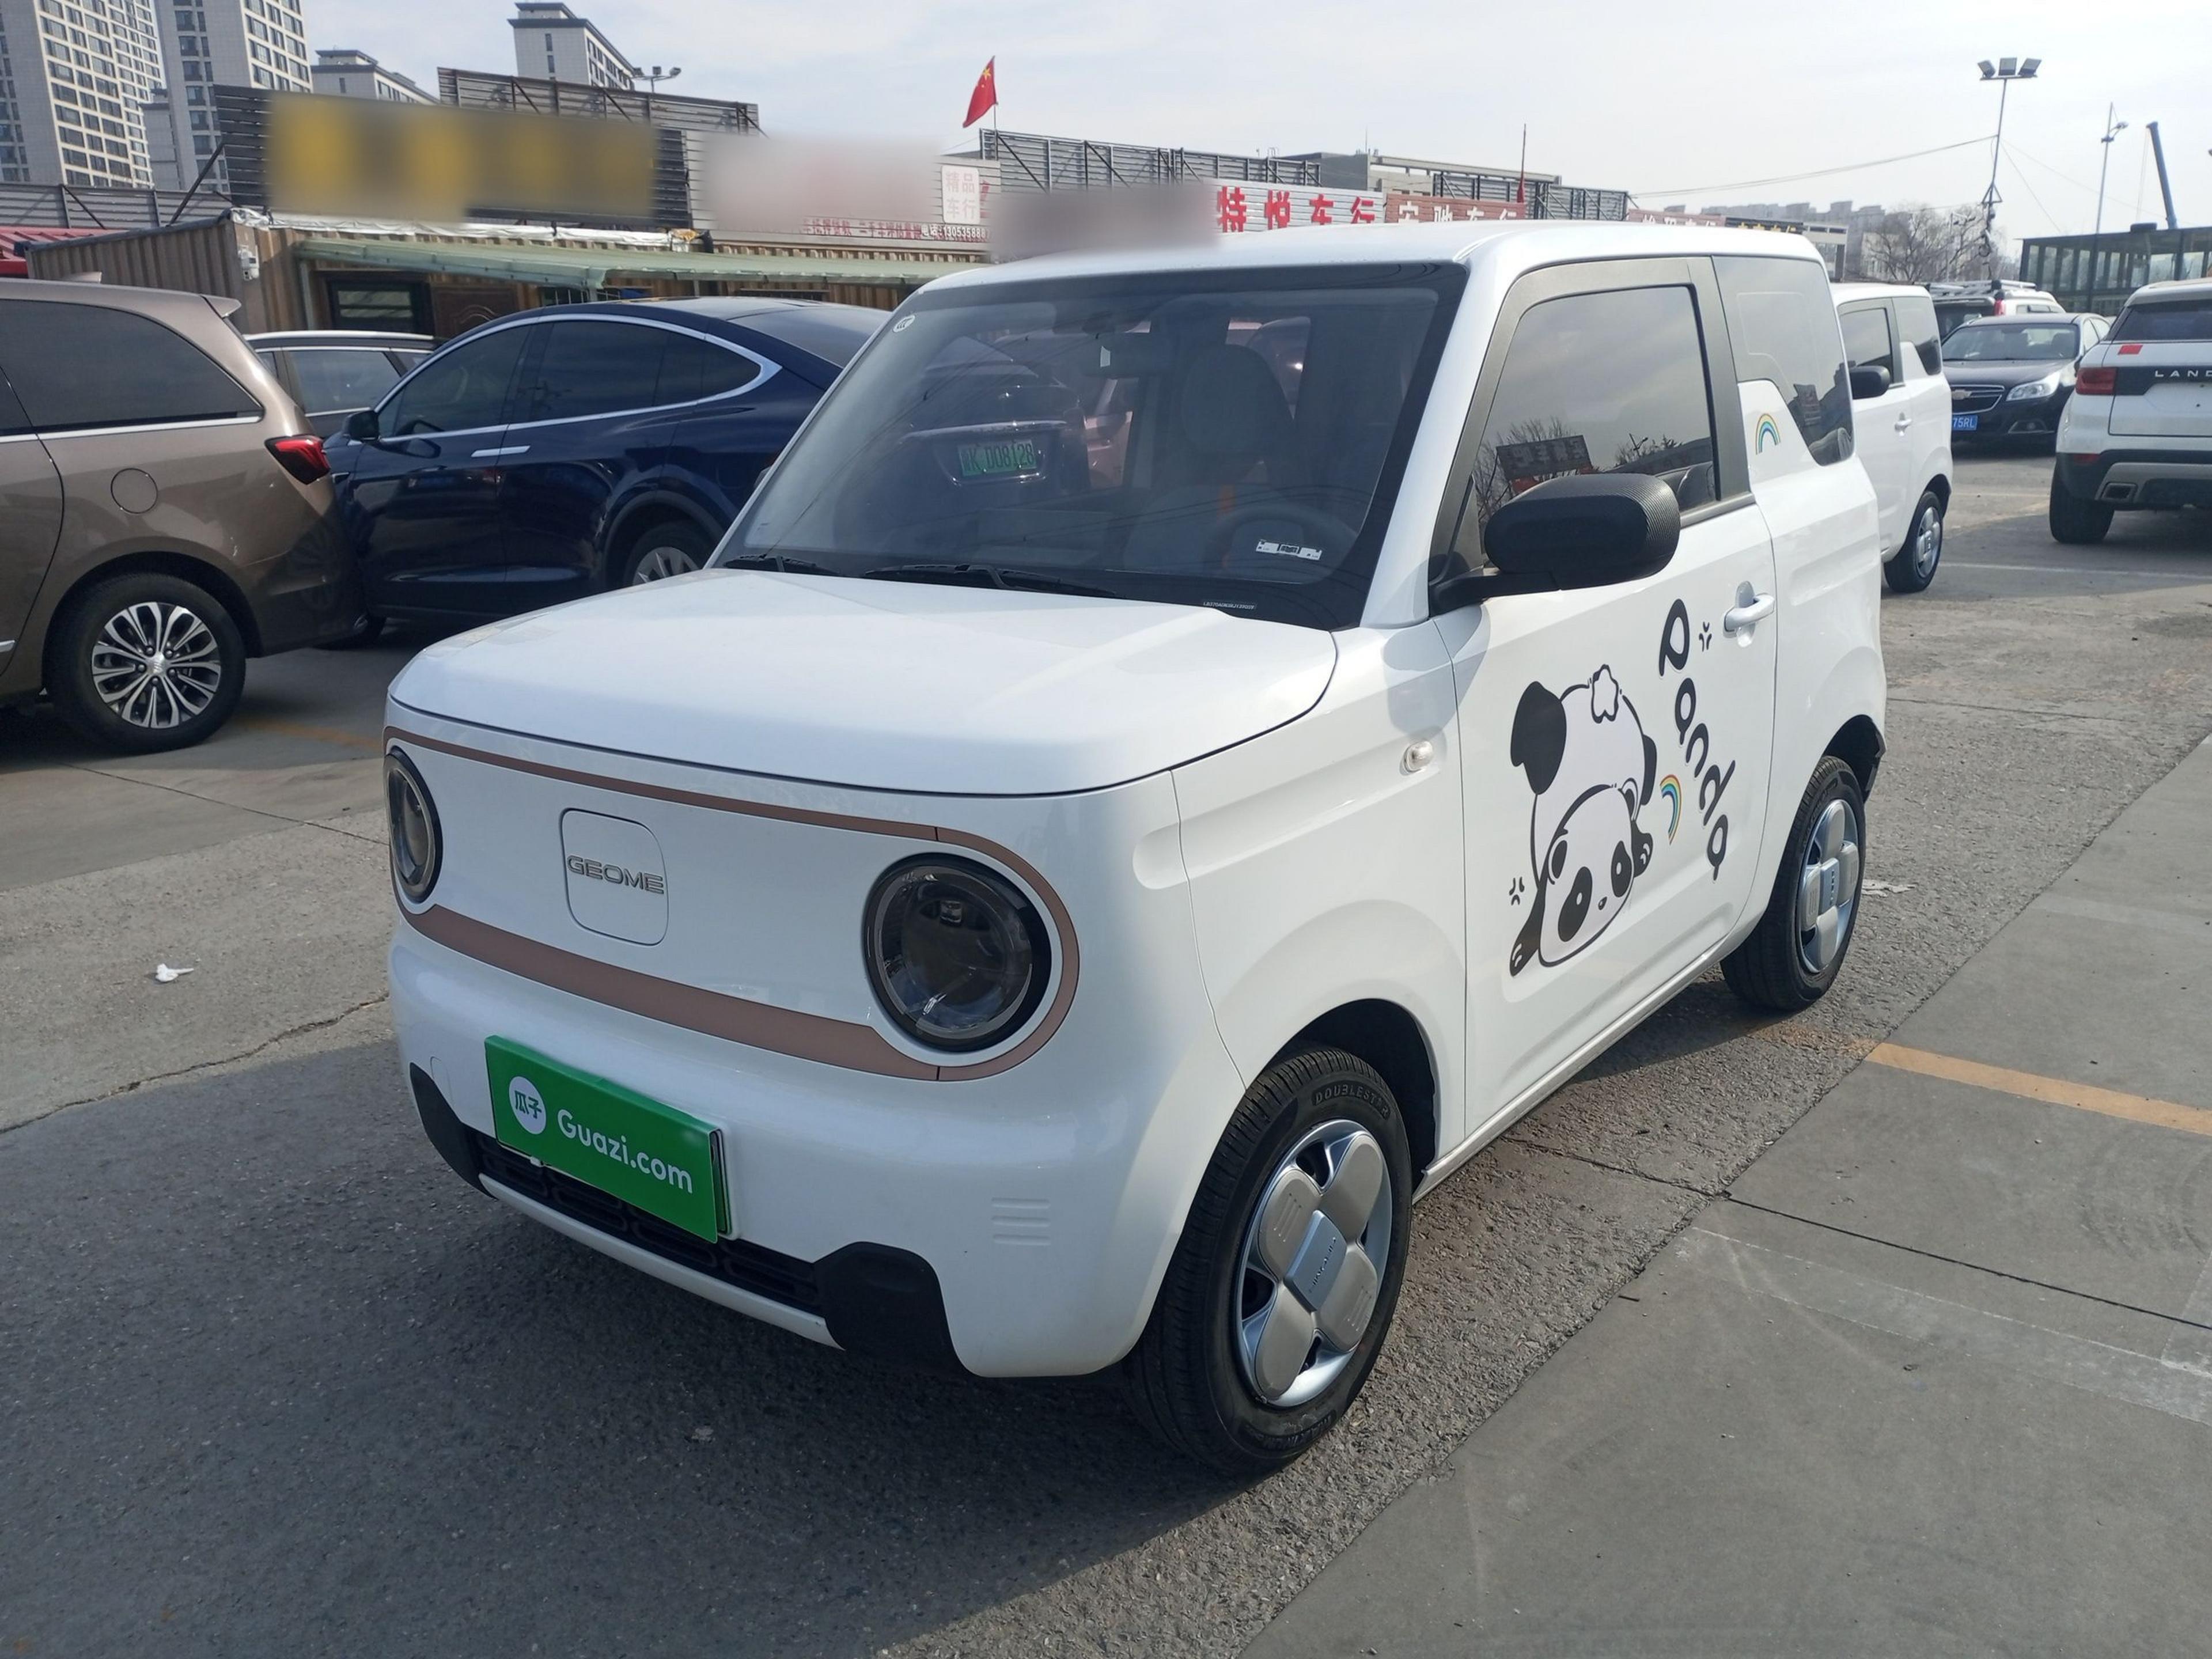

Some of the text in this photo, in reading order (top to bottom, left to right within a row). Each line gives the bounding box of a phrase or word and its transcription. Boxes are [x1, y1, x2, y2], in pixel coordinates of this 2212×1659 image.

[946, 197, 976, 219] 车行
[1217, 185, 1376, 233] 特悦车行
[1658, 597, 1736, 881] Panda
[566, 855, 664, 895] GEOME
[514, 1089, 542, 1119] 瓜子
[557, 1108, 694, 1194] Guazi.com
